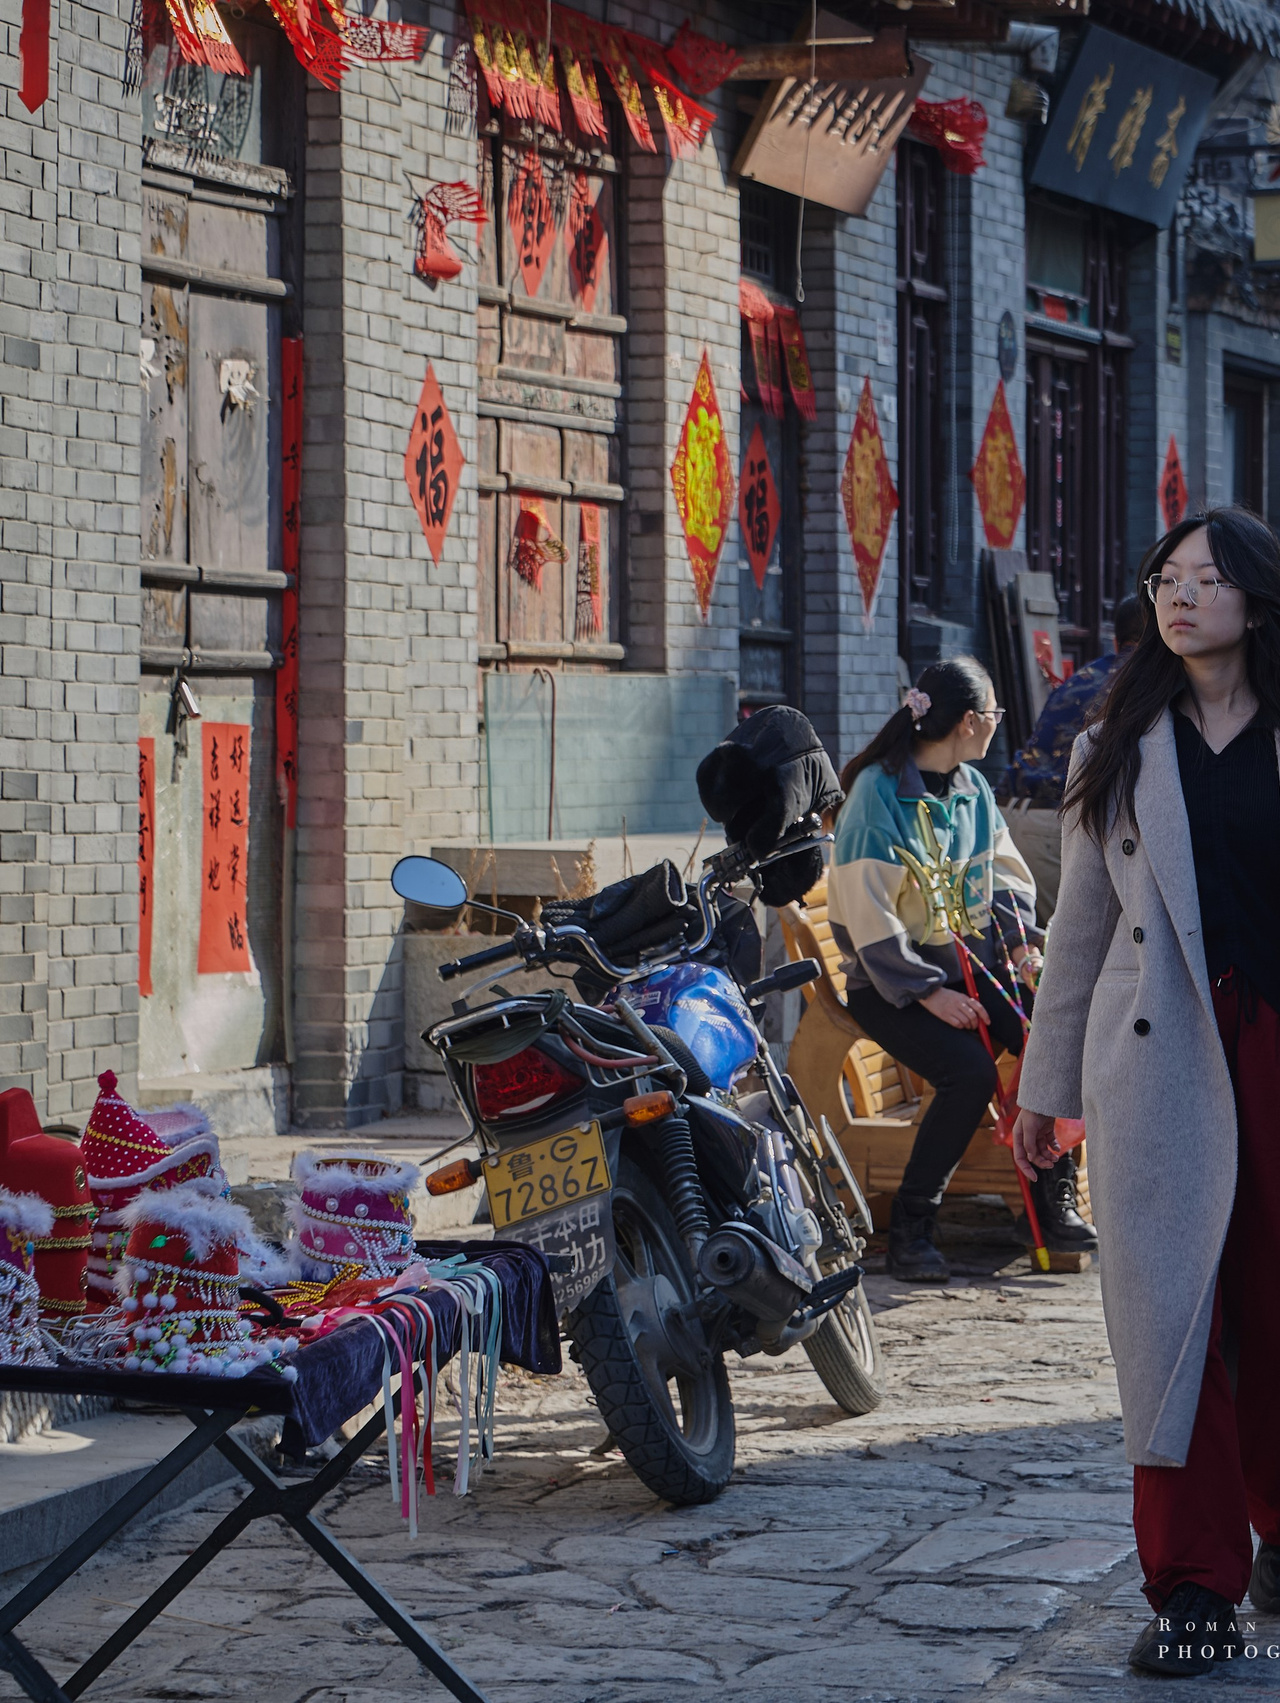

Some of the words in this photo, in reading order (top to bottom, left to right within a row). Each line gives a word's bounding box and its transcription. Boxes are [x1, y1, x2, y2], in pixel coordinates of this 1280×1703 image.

[416, 404, 448, 528] 福
[744, 458, 770, 556] 福
[495, 1156, 604, 1222] 7286Z
